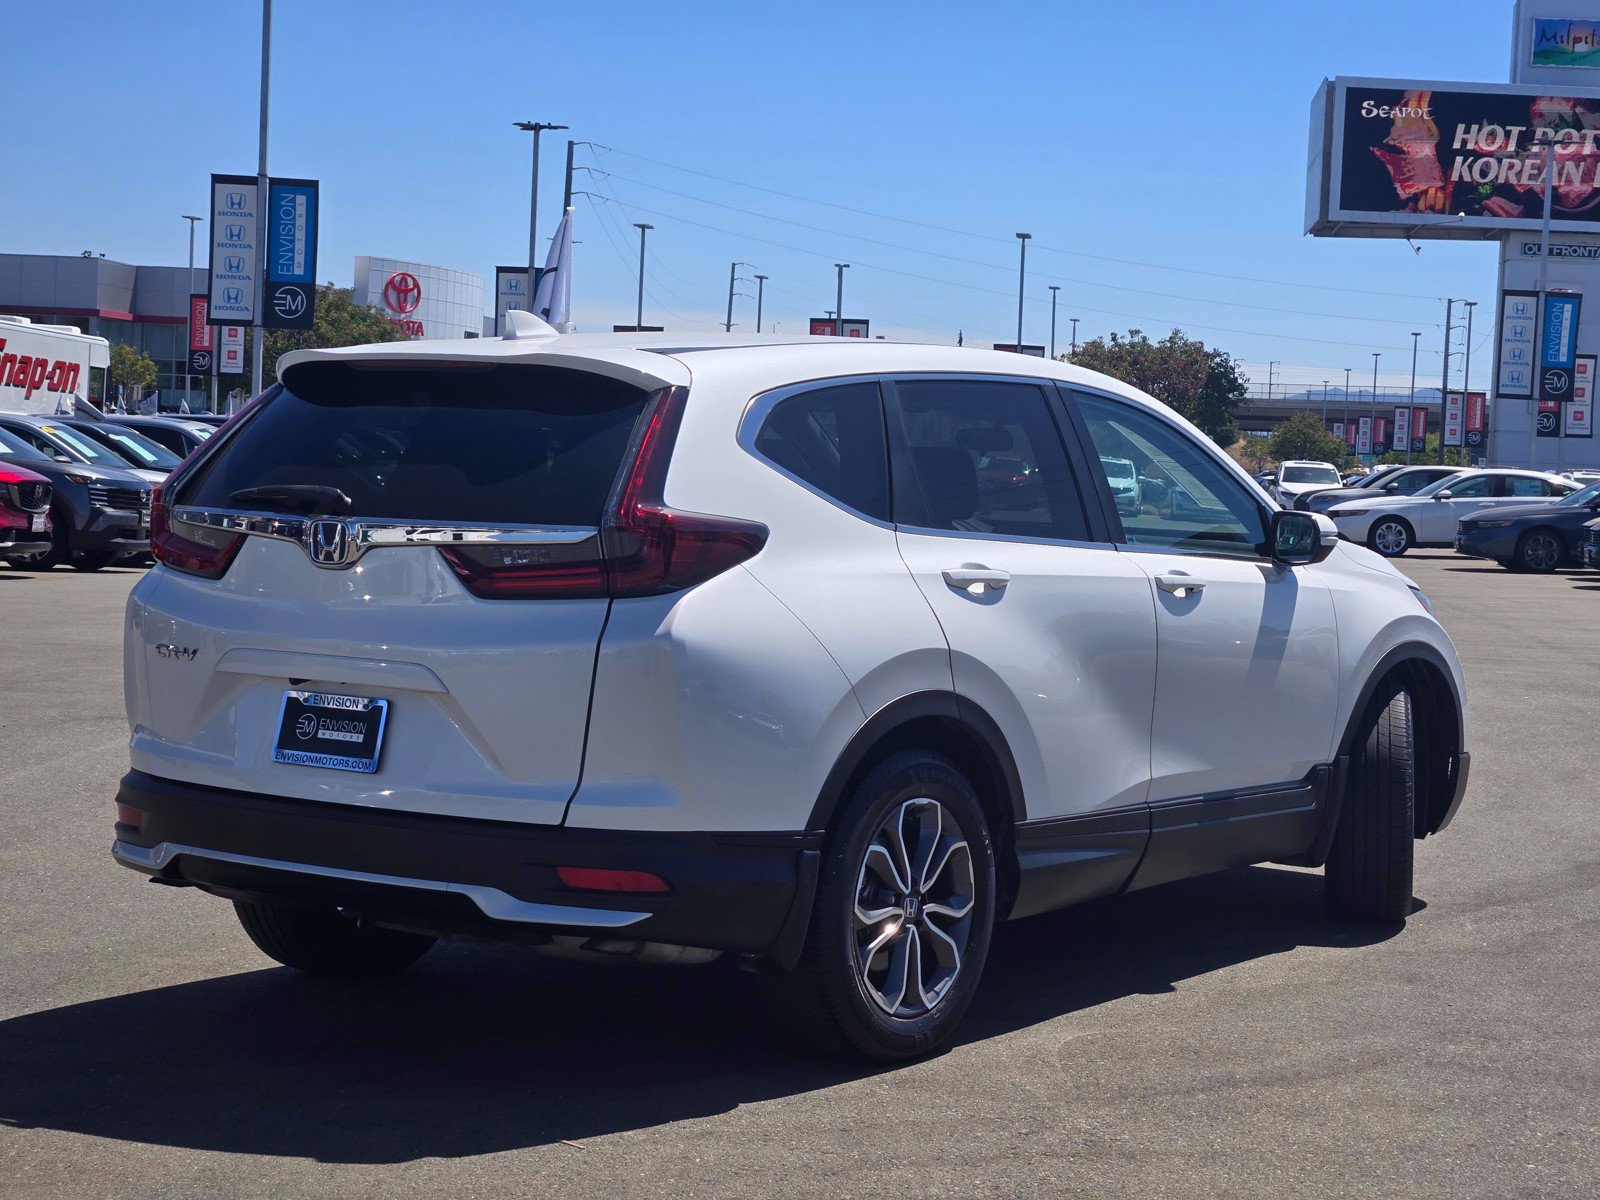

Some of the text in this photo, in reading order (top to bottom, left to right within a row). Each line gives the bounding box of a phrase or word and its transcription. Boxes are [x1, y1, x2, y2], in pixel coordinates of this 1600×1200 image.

[1537, 21, 1600, 55] Milpit
[1452, 123, 1600, 155] HOT POT
[1451, 156, 1585, 186] KOREAN
[278, 193, 295, 275] ENVISION
[194, 302, 204, 347] ENVISION
[1548, 303, 1563, 361] ENVISION
[313, 694, 360, 709] ENVISION
[319, 718, 367, 733] ENVISION
[321, 732, 360, 740] MOTORS
[275, 751, 372, 770] ENVISIONMOTORS.COM
